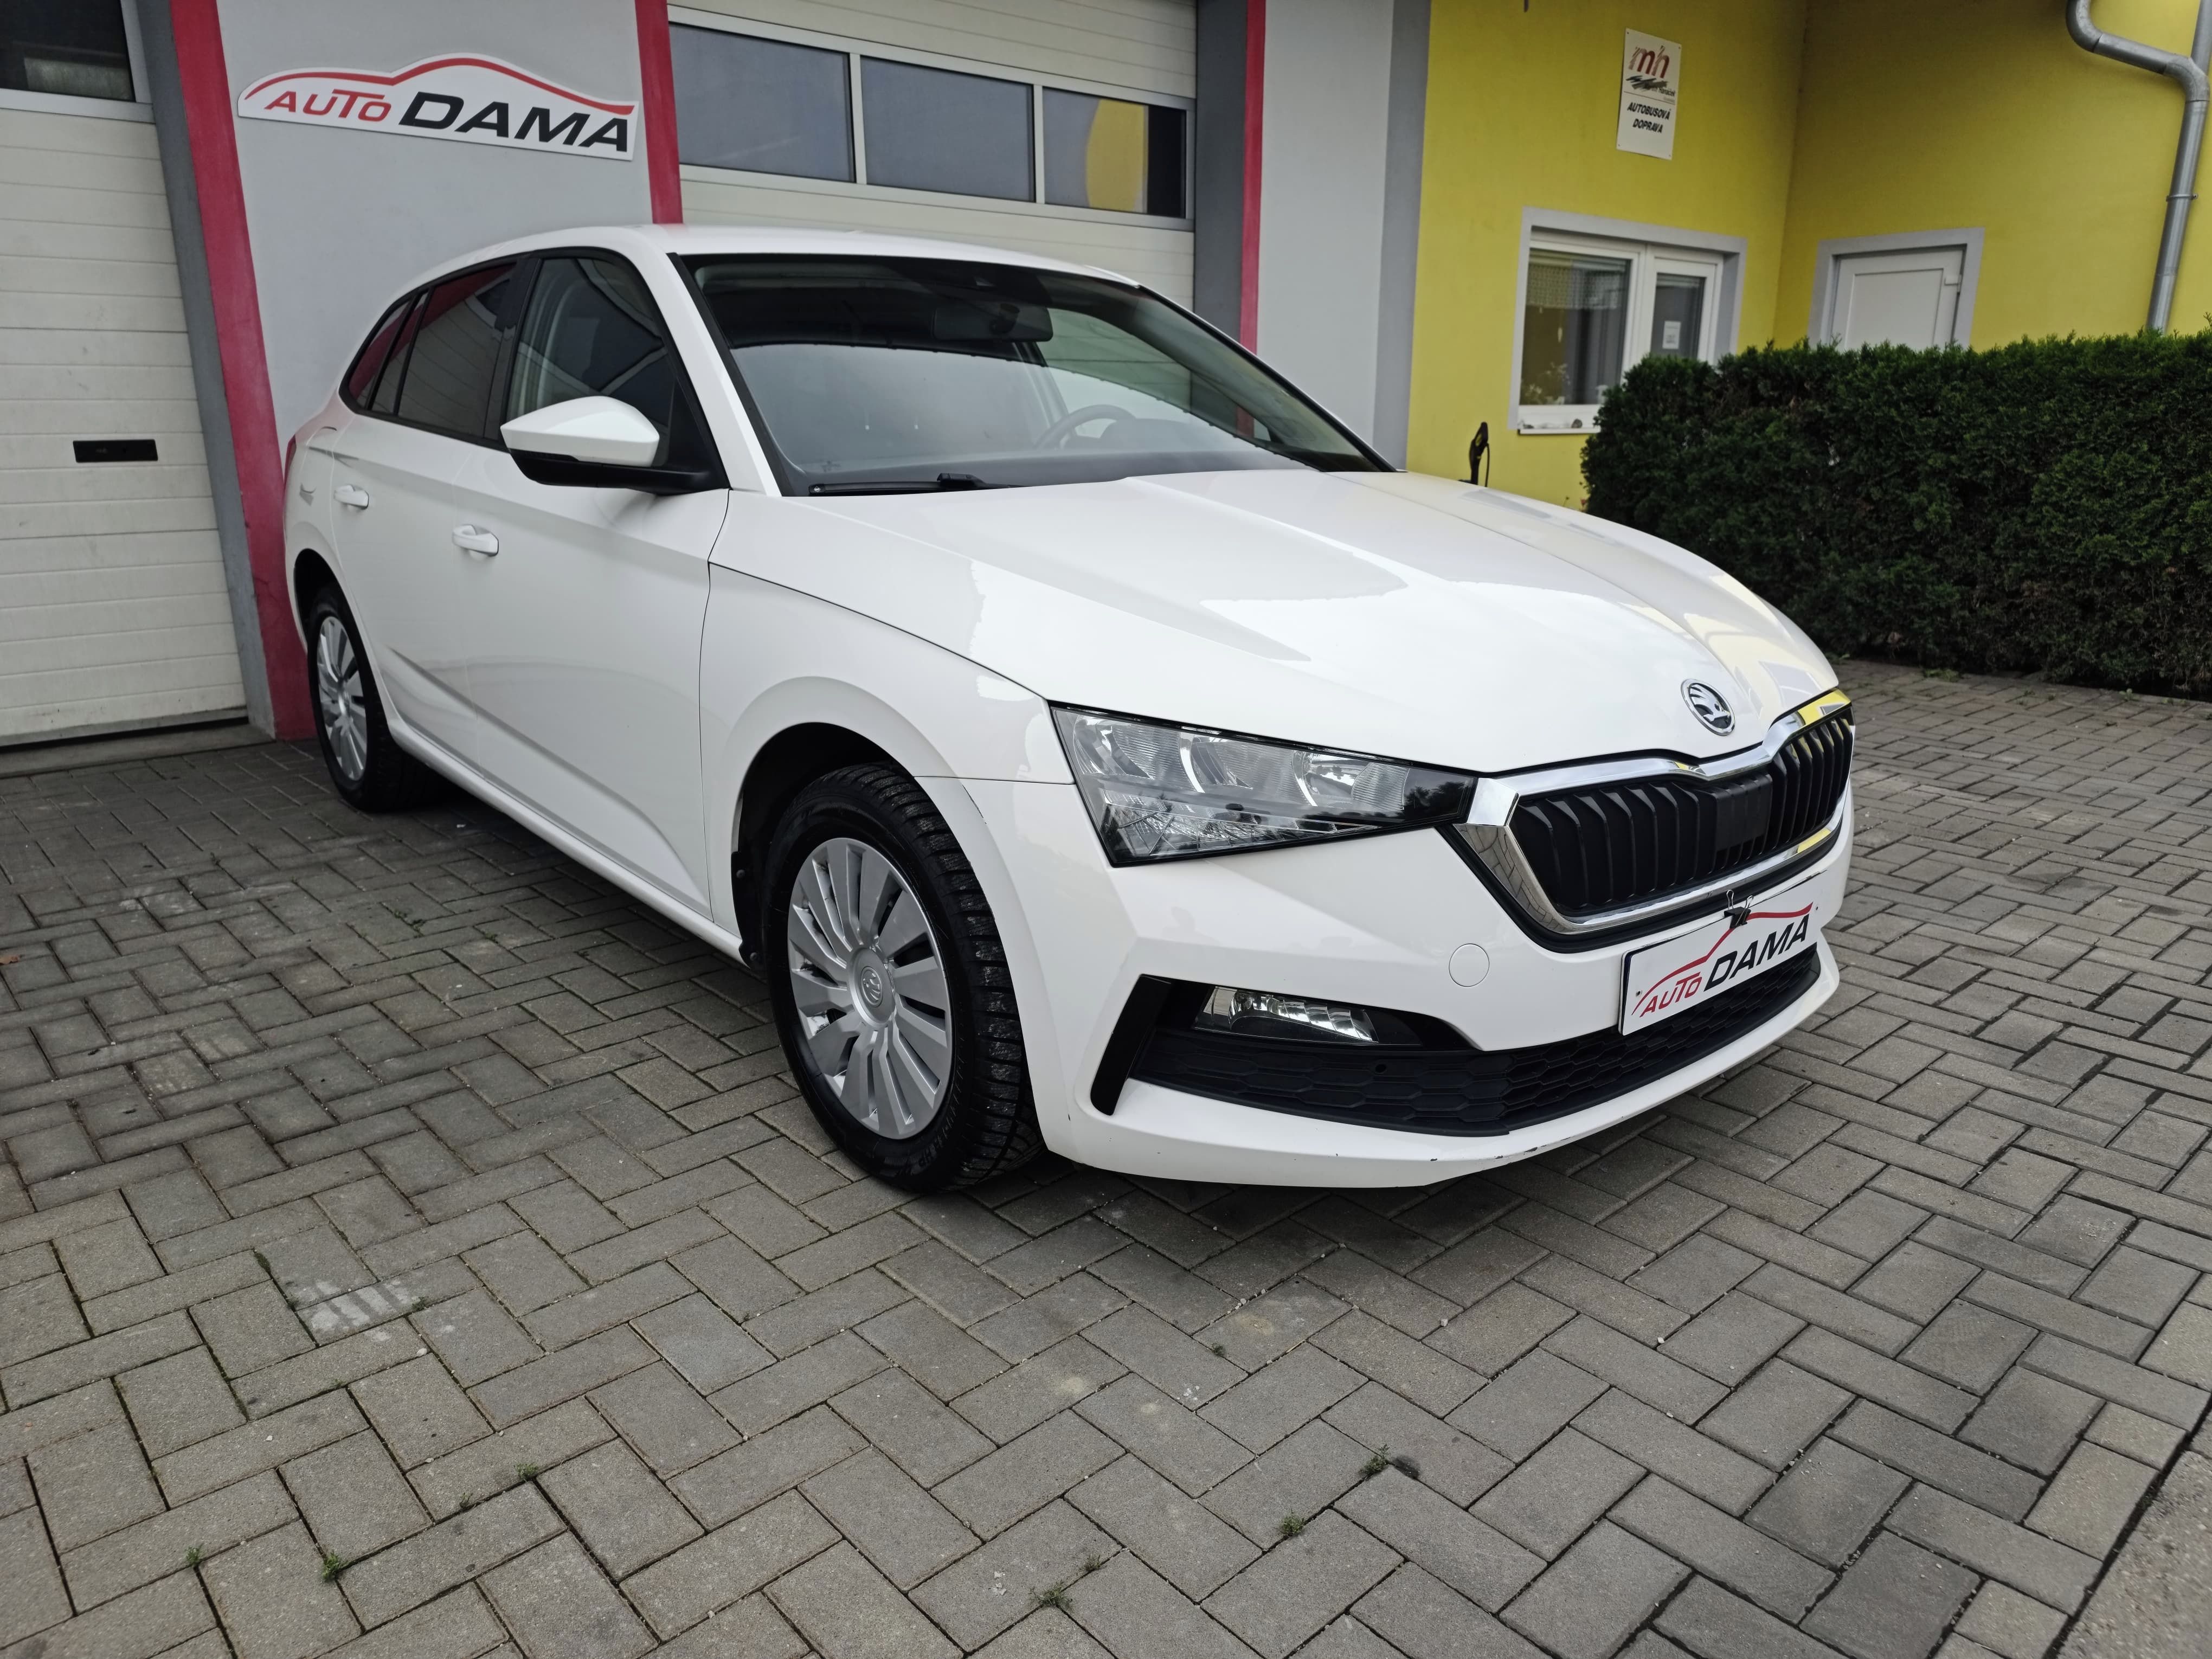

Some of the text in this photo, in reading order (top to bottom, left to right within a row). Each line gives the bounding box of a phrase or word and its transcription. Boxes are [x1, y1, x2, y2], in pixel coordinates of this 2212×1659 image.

[398, 92, 628, 152] DAMA
[1627, 102, 1670, 120] AUTOBUSOVÁ
[1632, 119, 1663, 133] DOPRAVA
[1703, 914, 1810, 992] DAMA
